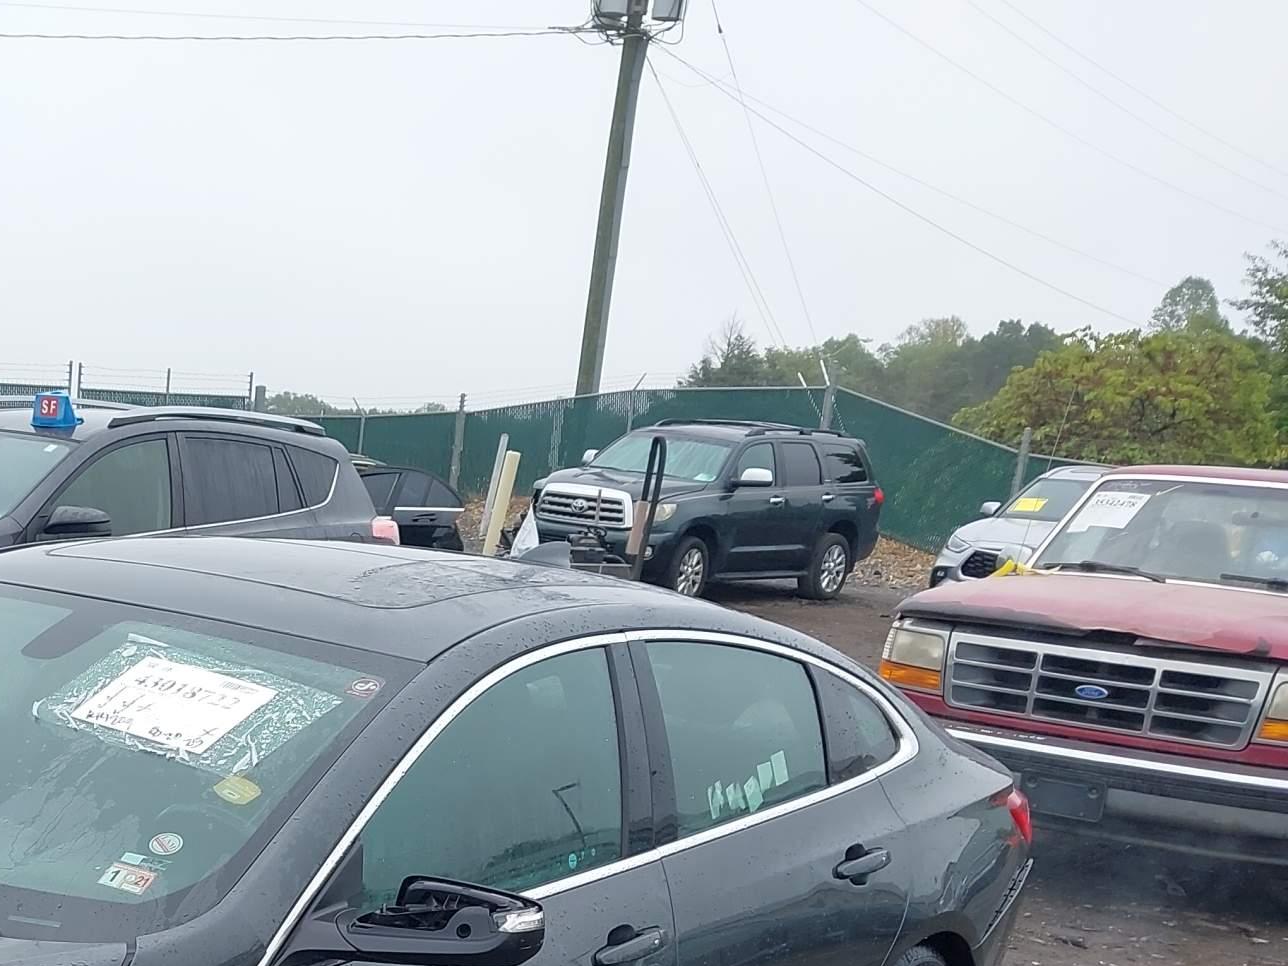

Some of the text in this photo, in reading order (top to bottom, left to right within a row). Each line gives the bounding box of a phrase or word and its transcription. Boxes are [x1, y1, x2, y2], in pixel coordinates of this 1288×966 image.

[41, 399, 57, 414] SF
[134, 674, 241, 709] 43018722
[135, 875, 150, 888] 21
